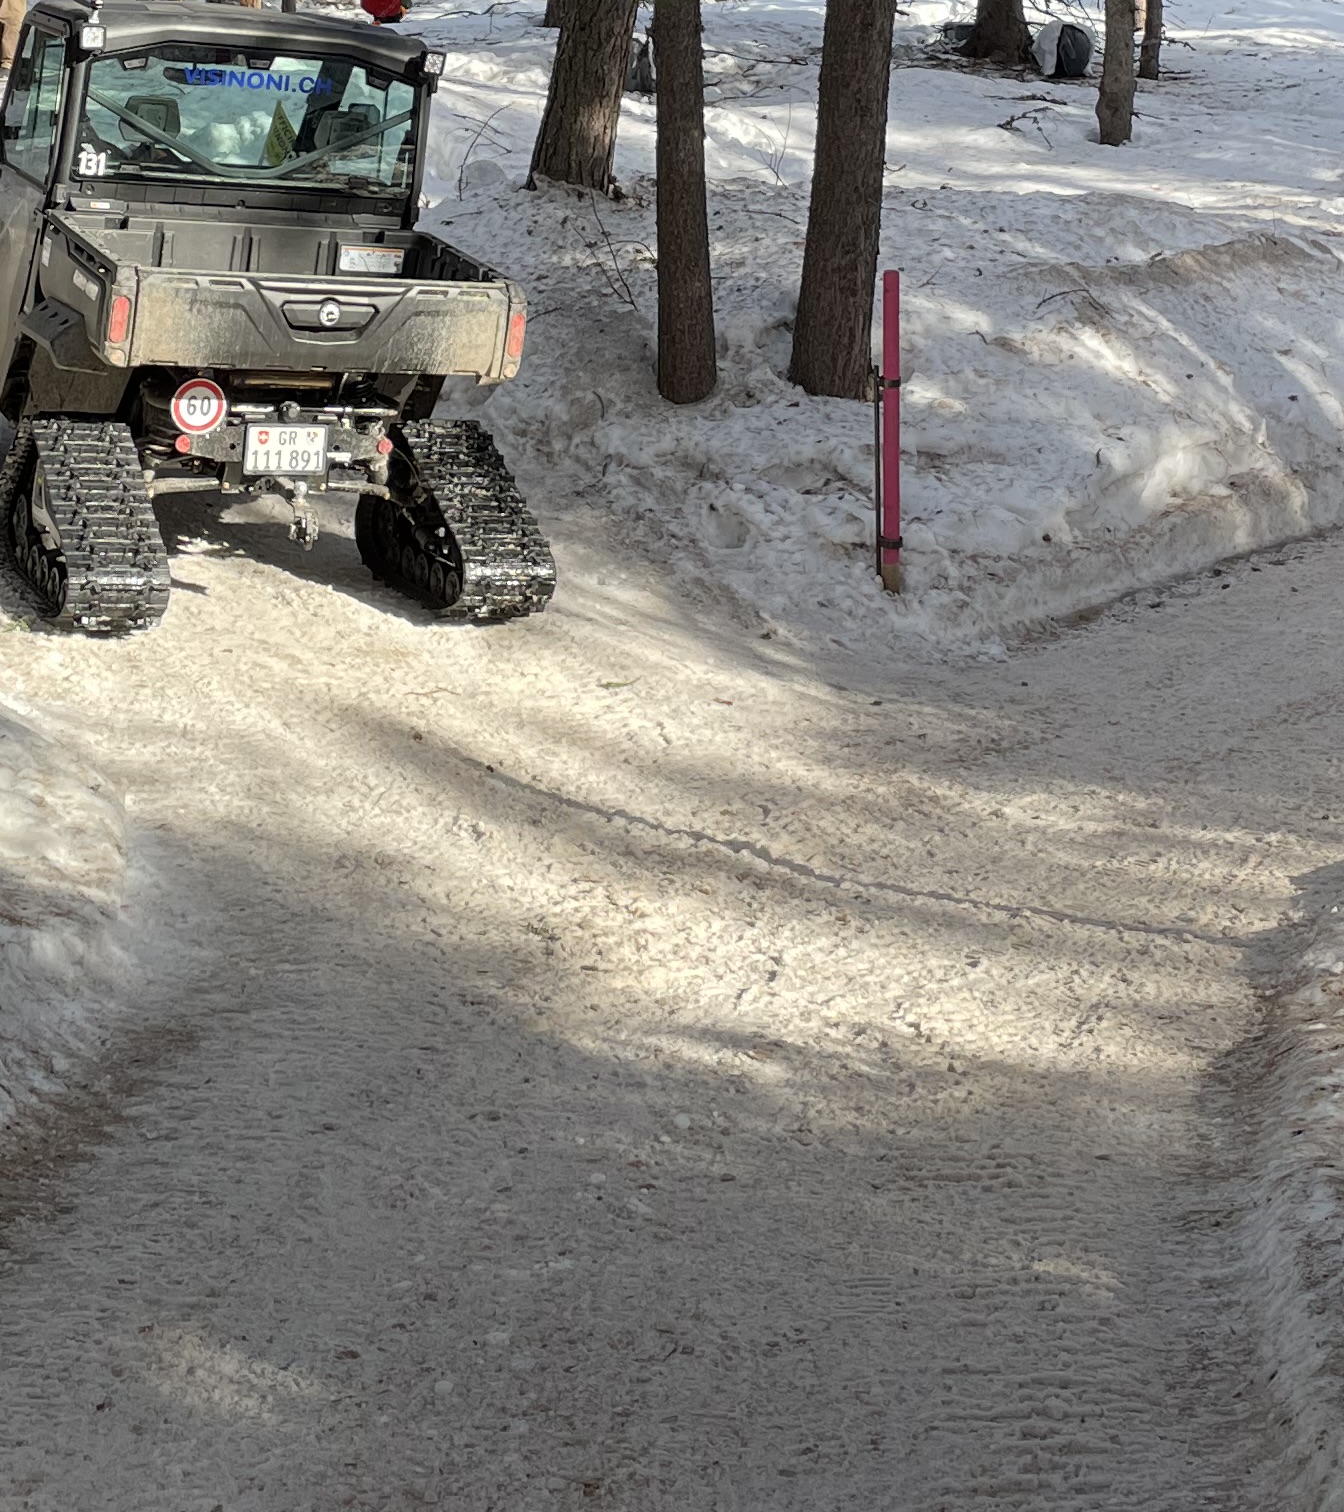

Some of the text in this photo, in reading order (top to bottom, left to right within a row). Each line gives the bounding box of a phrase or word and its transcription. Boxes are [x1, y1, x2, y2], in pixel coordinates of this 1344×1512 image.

[184, 66, 333, 95] VISINONI.CH
[77, 150, 106, 176] 131
[186, 395, 211, 416] 60
[278, 430, 297, 446] GR
